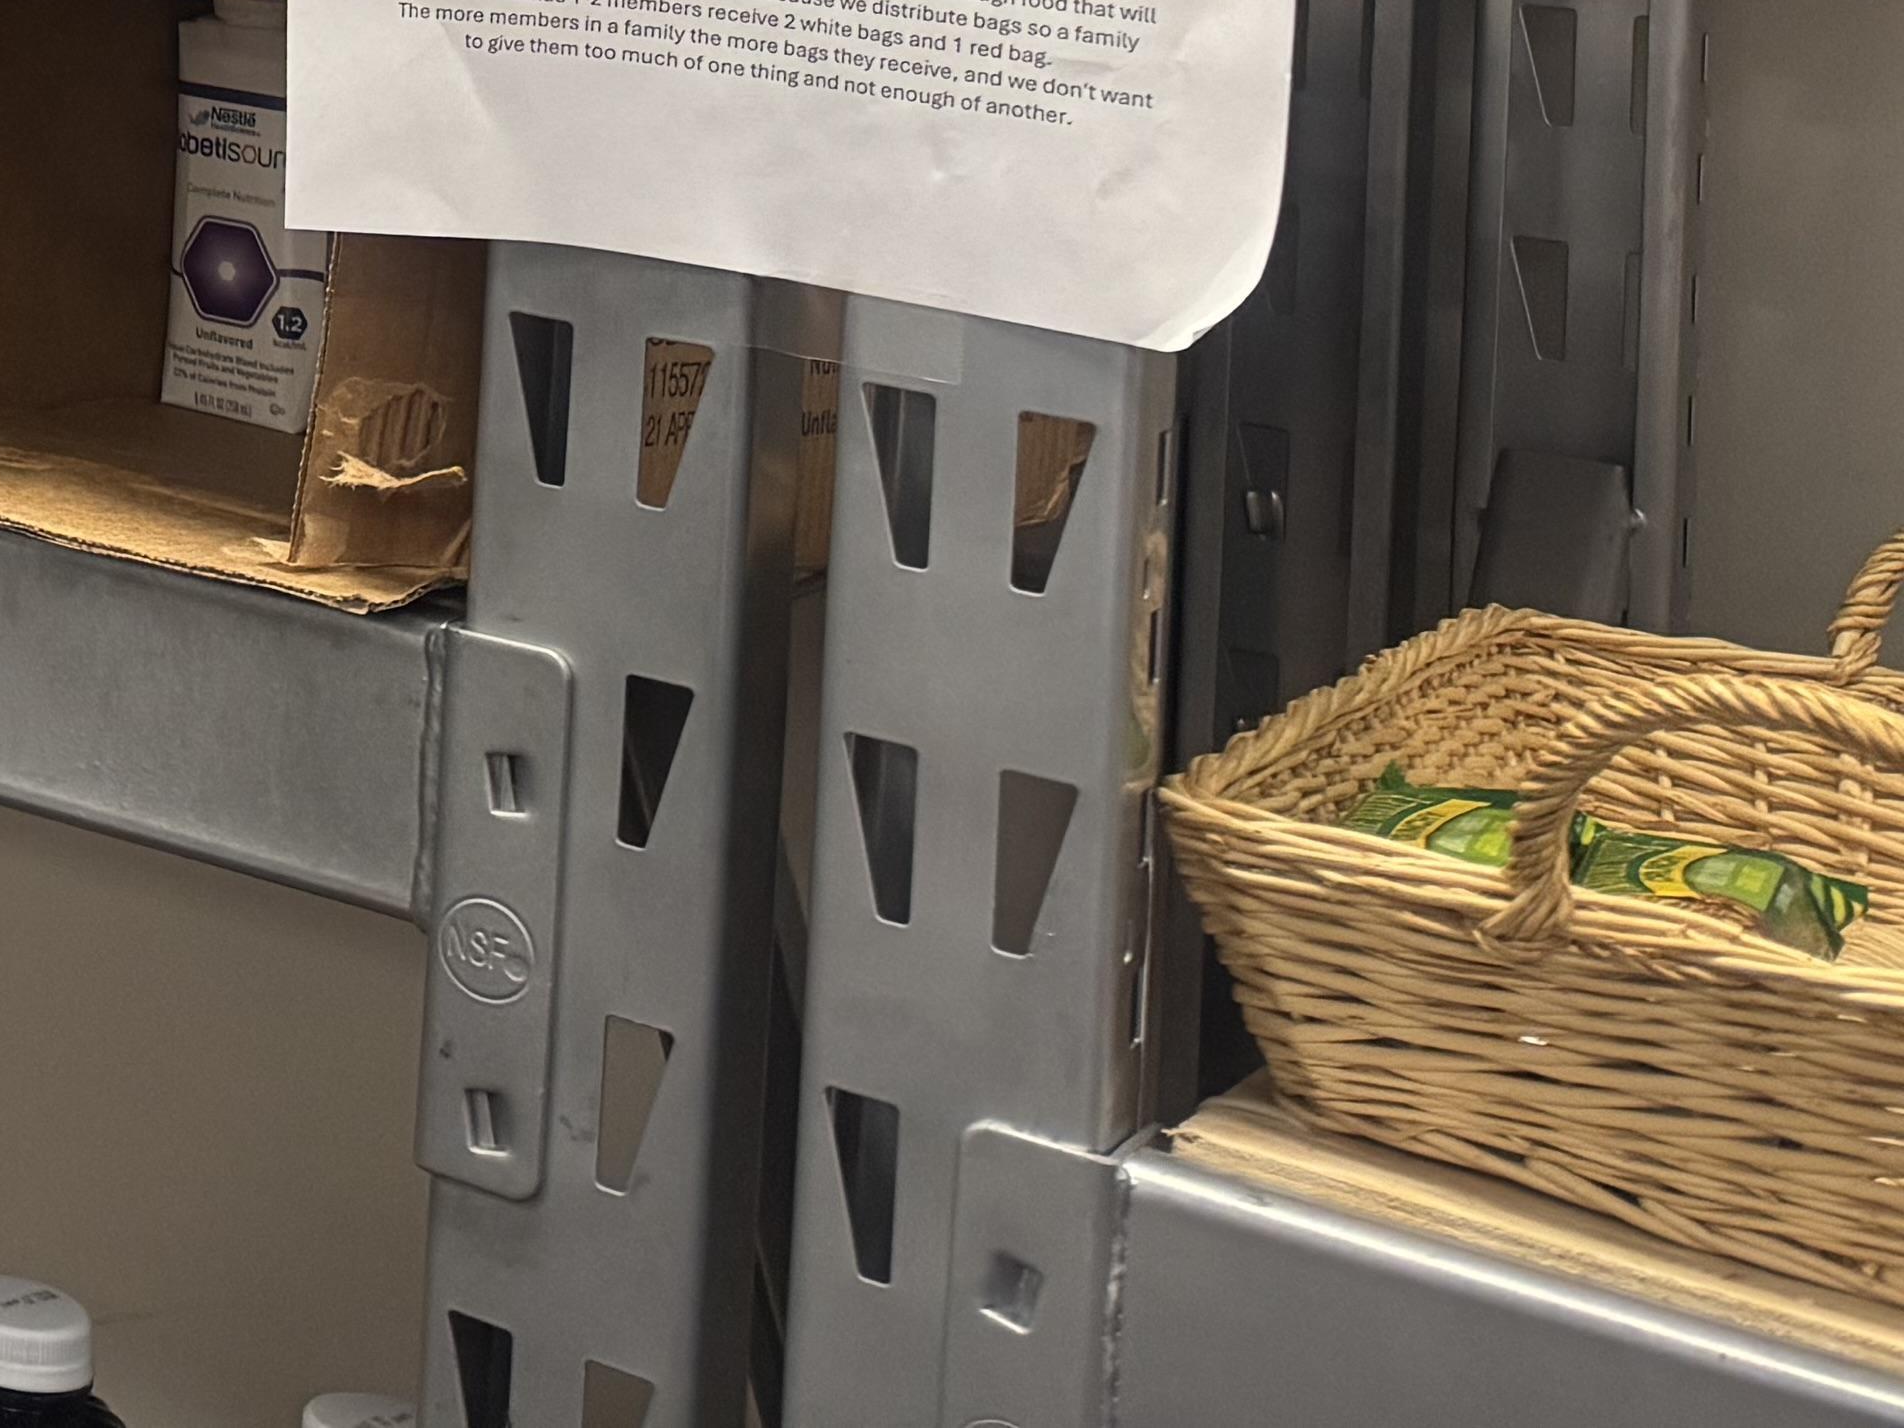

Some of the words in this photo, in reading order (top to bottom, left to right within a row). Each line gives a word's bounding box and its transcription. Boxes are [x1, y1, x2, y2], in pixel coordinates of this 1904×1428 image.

[464, 33, 484, 50] to
[487, 34, 526, 55] give
[529, 37, 579, 57] them
[584, 42, 617, 61] too
[621, 49, 678, 69] much
[683, 55, 704, 71] of
[708, 60, 746, 77] one
[750, 63, 800, 89] thing
[803, 73, 840, 91] and
[844, 79, 877, 97] not
[880, 85, 955, 111] enough
[960, 95, 982, 112] of
[985, 100, 1073, 126] another.
